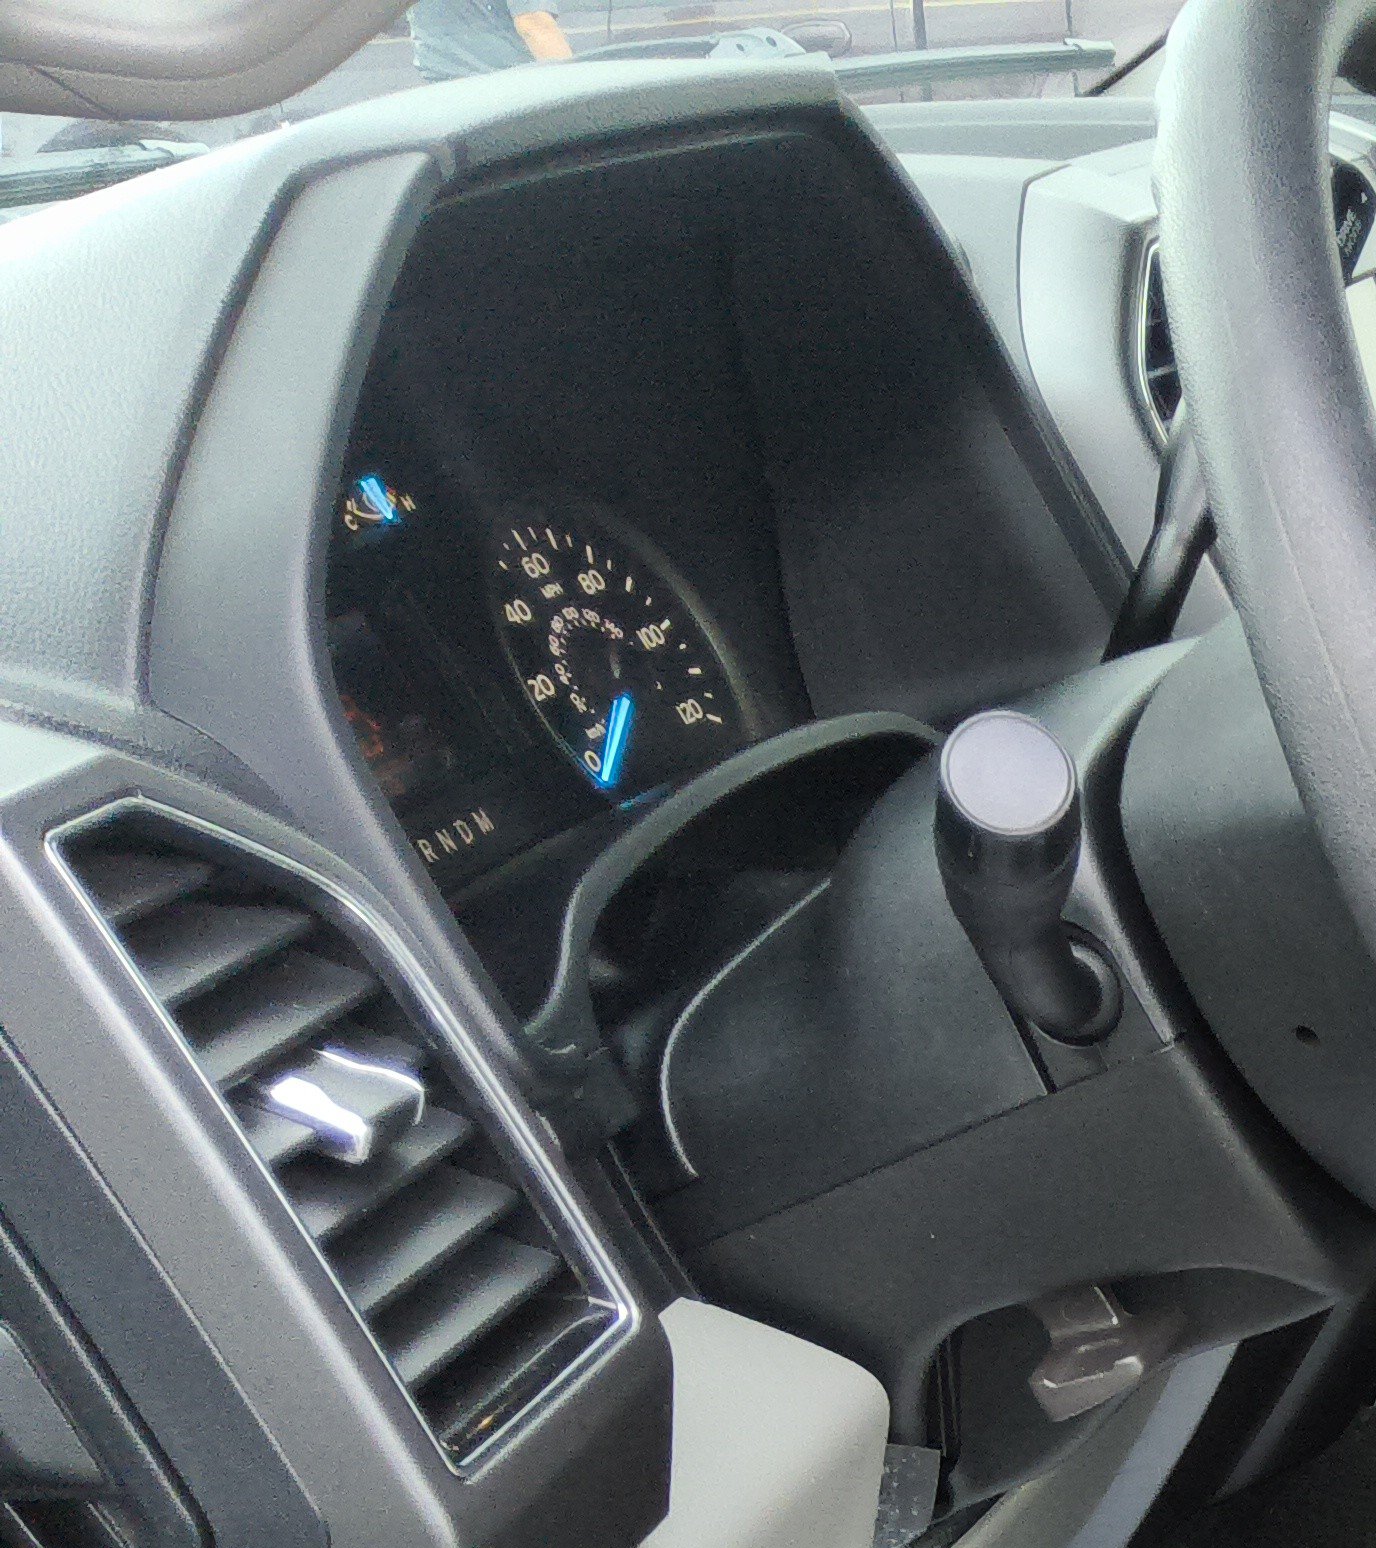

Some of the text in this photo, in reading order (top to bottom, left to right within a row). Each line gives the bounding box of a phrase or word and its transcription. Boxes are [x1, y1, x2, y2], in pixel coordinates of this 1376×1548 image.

[521, 552, 549, 578] 60
[577, 569, 606, 595] 80
[504, 599, 531, 624] 40
[635, 624, 666, 651] 100
[527, 674, 555, 701] 20
[675, 698, 703, 724] 120
[584, 750, 601, 773] 0
